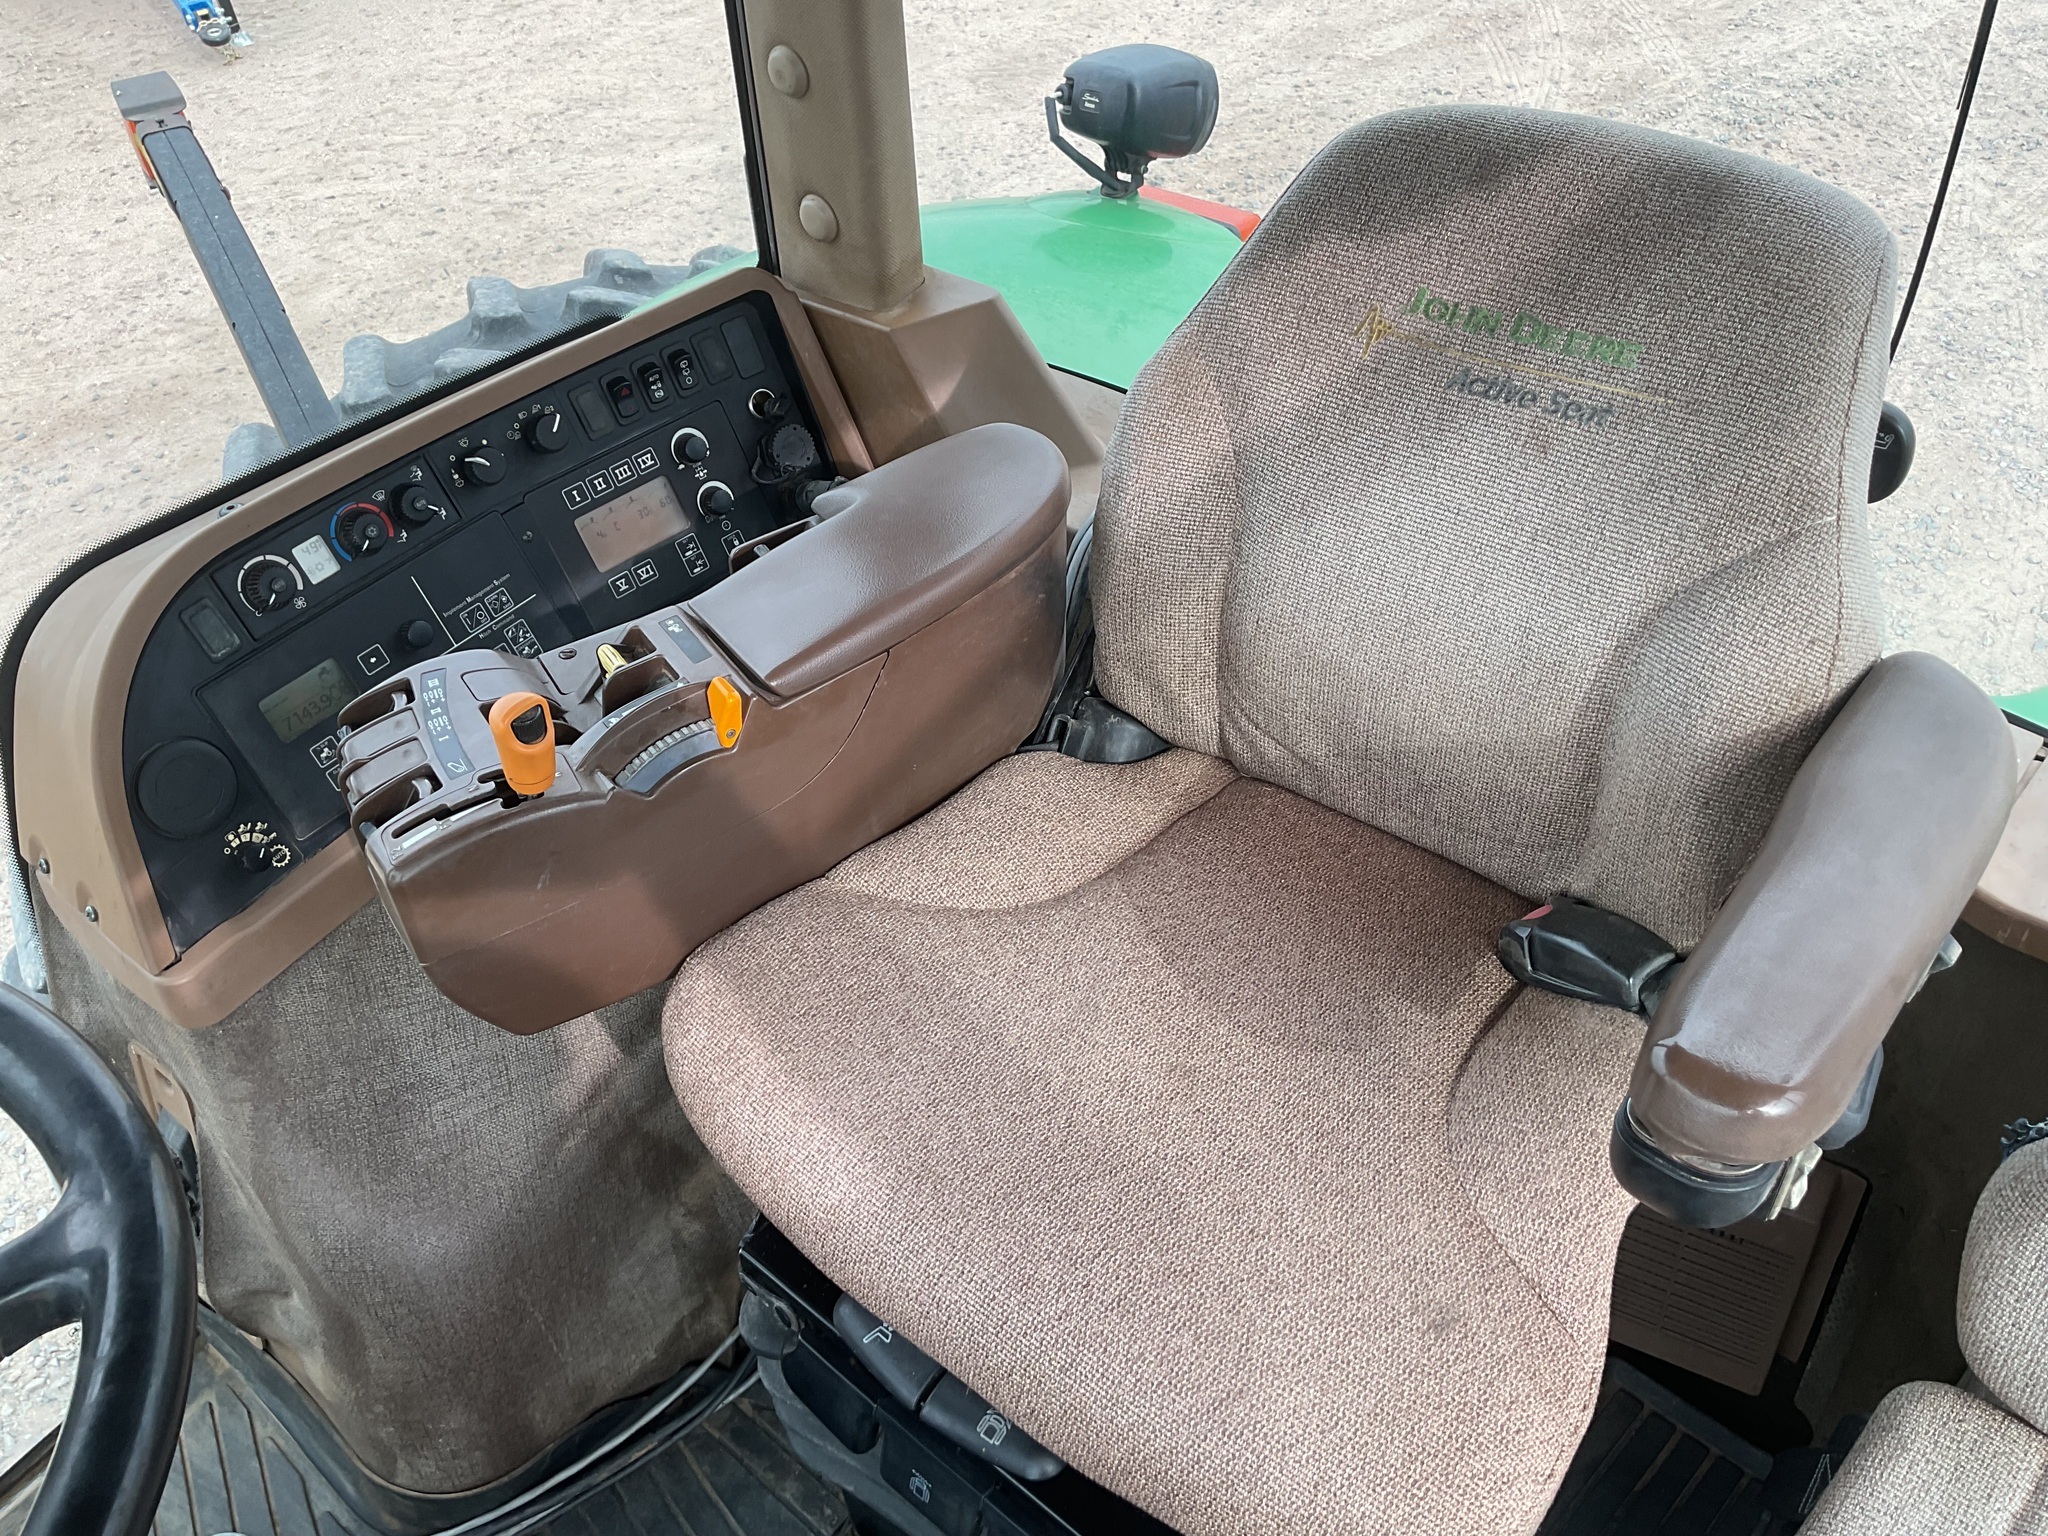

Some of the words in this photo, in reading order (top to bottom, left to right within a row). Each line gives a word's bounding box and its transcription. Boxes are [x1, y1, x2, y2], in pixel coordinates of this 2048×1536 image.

[1402, 285, 1504, 337] JOHN
[1508, 310, 1645, 370] DEERE
[1444, 367, 1538, 410] Active
[637, 454, 656, 469] IV
[614, 465, 632, 481] III
[592, 477, 607, 490] II
[638, 563, 656, 579] VI
[493, 572, 511, 587] System
[615, 577, 629, 592] V
[492, 613, 515, 631] Command
[272, 849, 286, 863] AUTO
